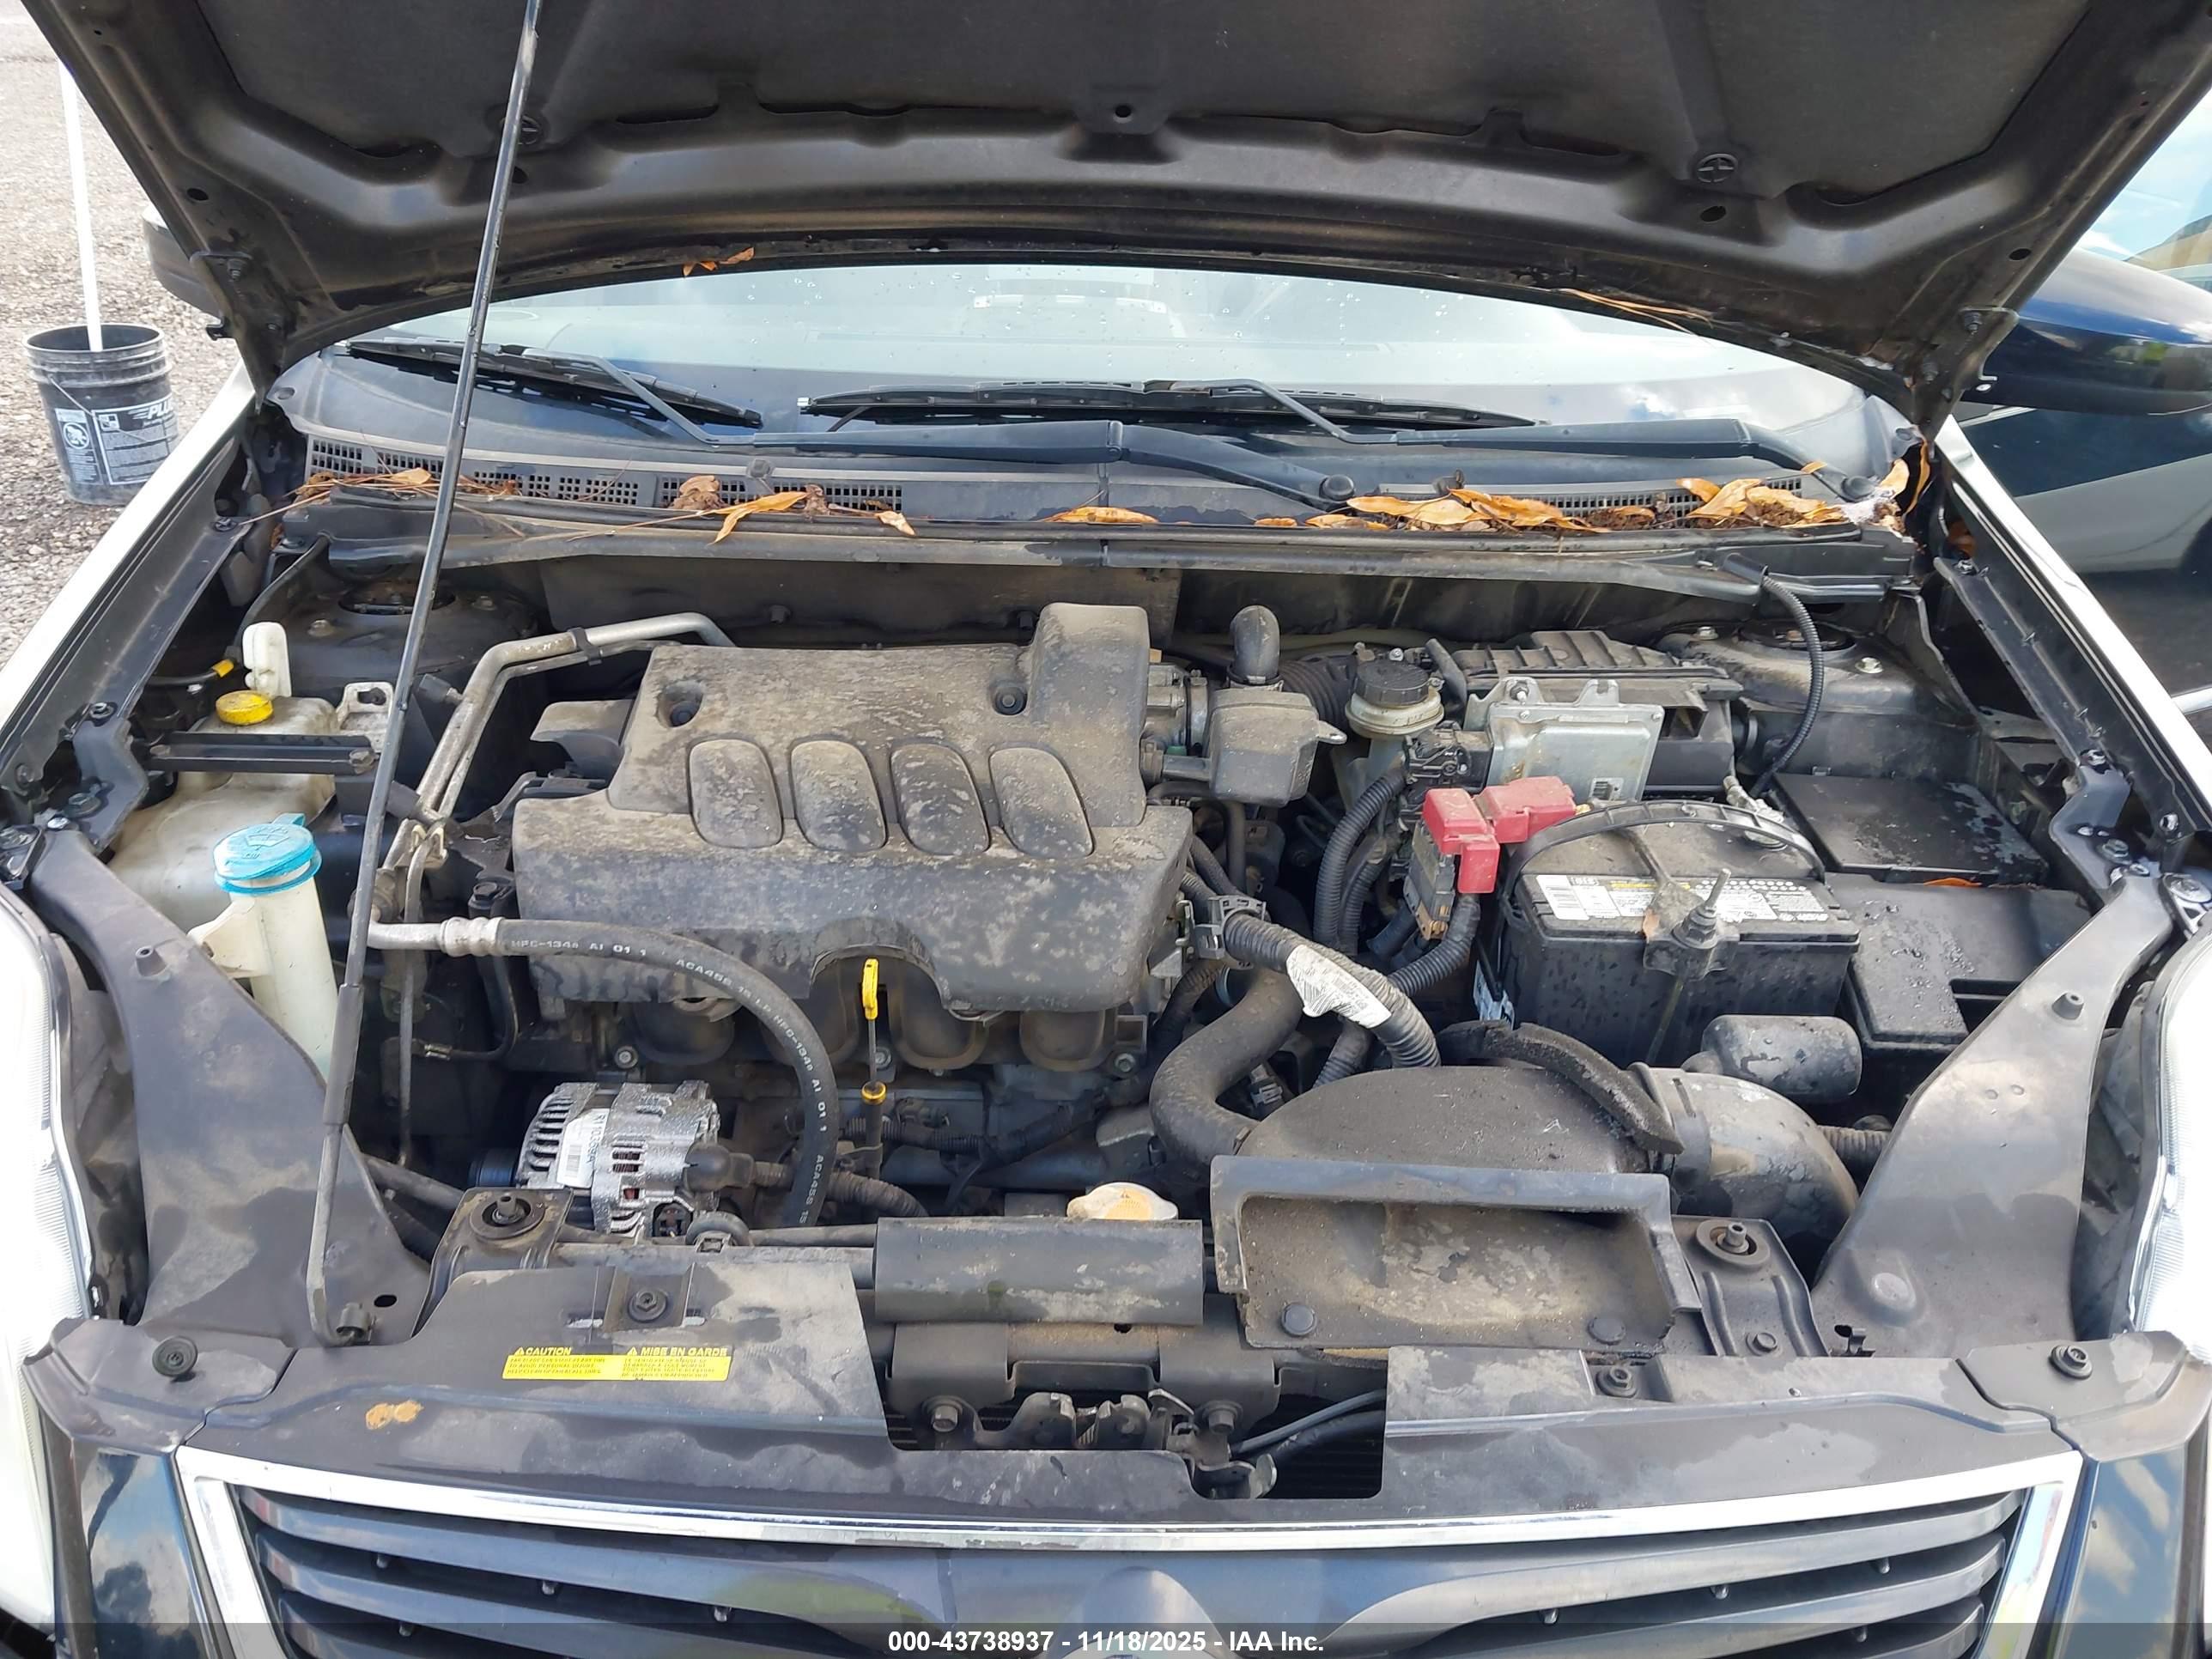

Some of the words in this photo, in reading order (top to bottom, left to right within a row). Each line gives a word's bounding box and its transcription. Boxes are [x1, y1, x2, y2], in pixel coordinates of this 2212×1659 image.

[526, 1346, 572, 1356] CAUTION
[641, 1346, 668, 1356] MISE
[670, 1346, 685, 1356] EN
[688, 1346, 728, 1357] GARDE
